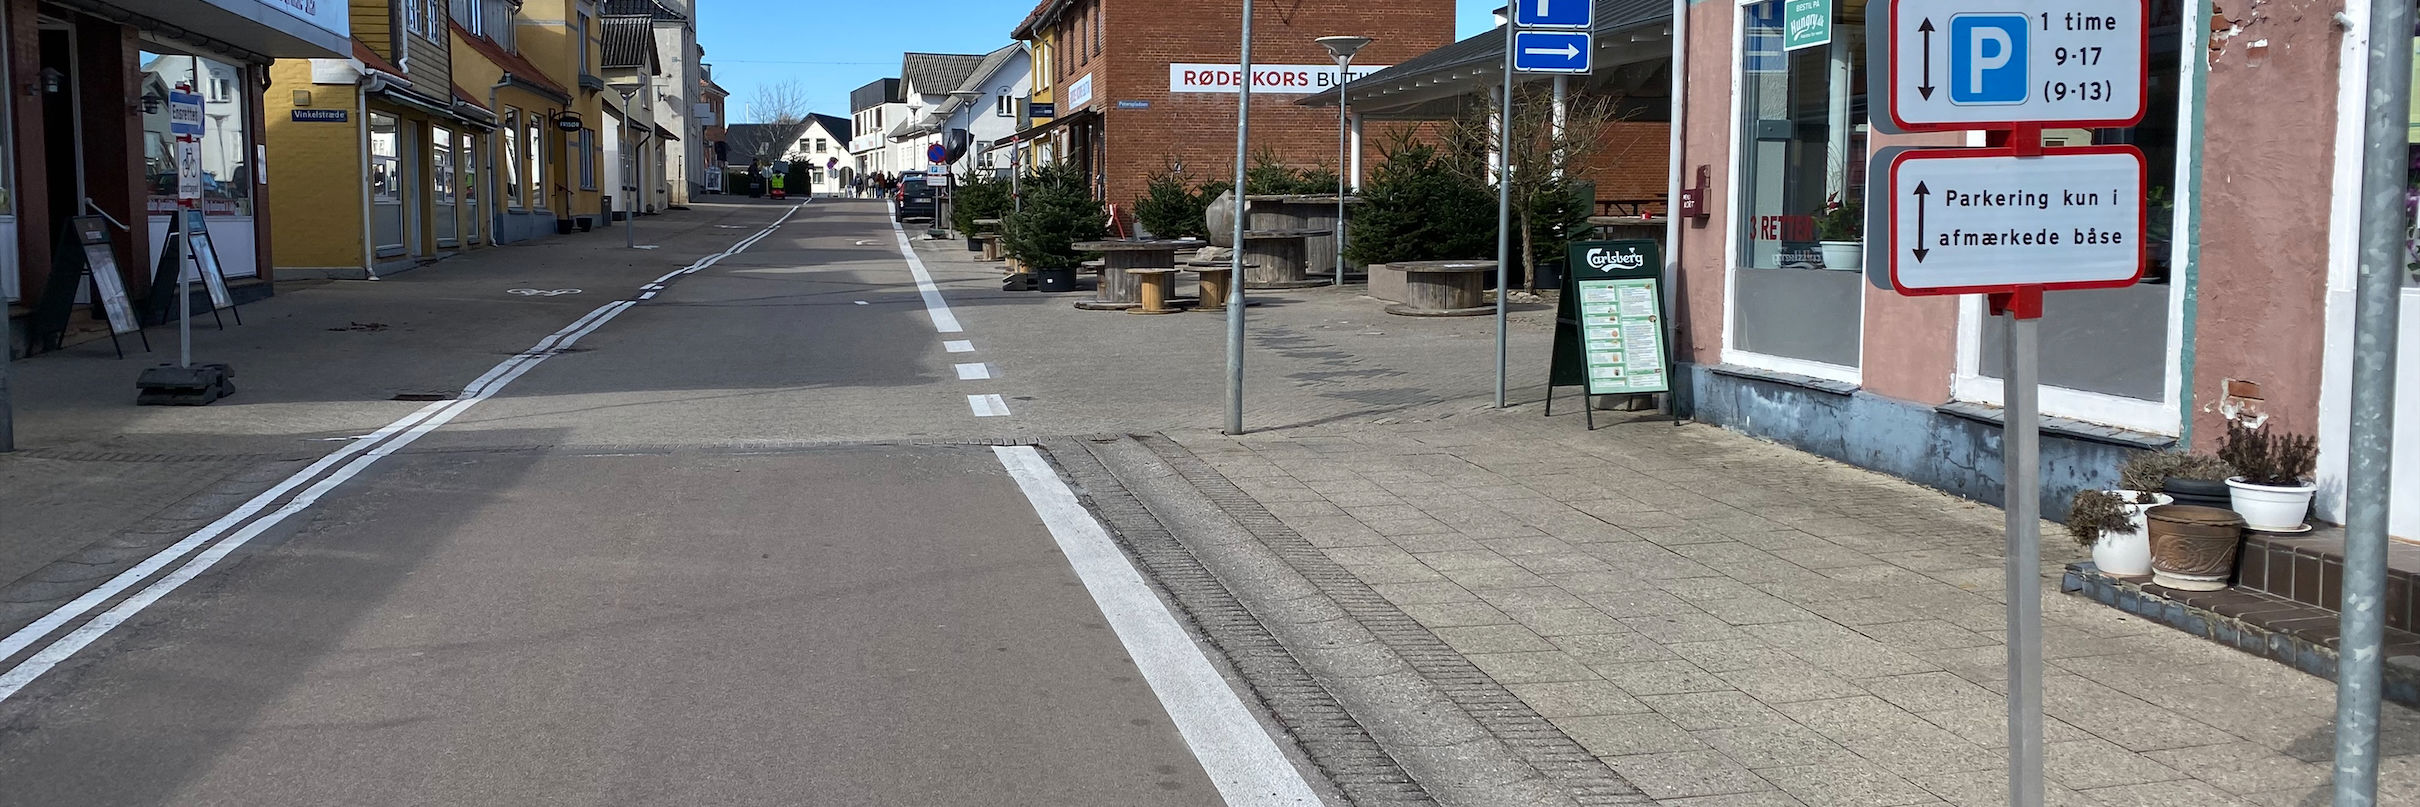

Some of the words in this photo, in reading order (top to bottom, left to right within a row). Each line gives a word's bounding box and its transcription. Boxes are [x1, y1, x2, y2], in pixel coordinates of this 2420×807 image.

[1796, 2, 1812, 12] BESTIL
[2041, 12, 2049, 31] 1
[2065, 12, 2117, 31] time
[1970, 26, 2013, 94] P
[2055, 47, 2103, 66] 9-17
[1184, 70, 1242, 86] RØDE
[1253, 71, 1309, 87] KORS
[2044, 80, 2112, 103] (9-13)
[294, 110, 345, 119] Vinkelstræde
[1946, 189, 2049, 209] Parkering
[2064, 189, 2099, 206] kun
[2113, 189, 2118, 206] i
[1750, 215, 1757, 241] 3
[1761, 215, 1815, 242] RETTER
[1939, 228, 2060, 246] afmærkede
[2074, 227, 2122, 244] båse
[1586, 247, 1644, 270] Carlsberg
